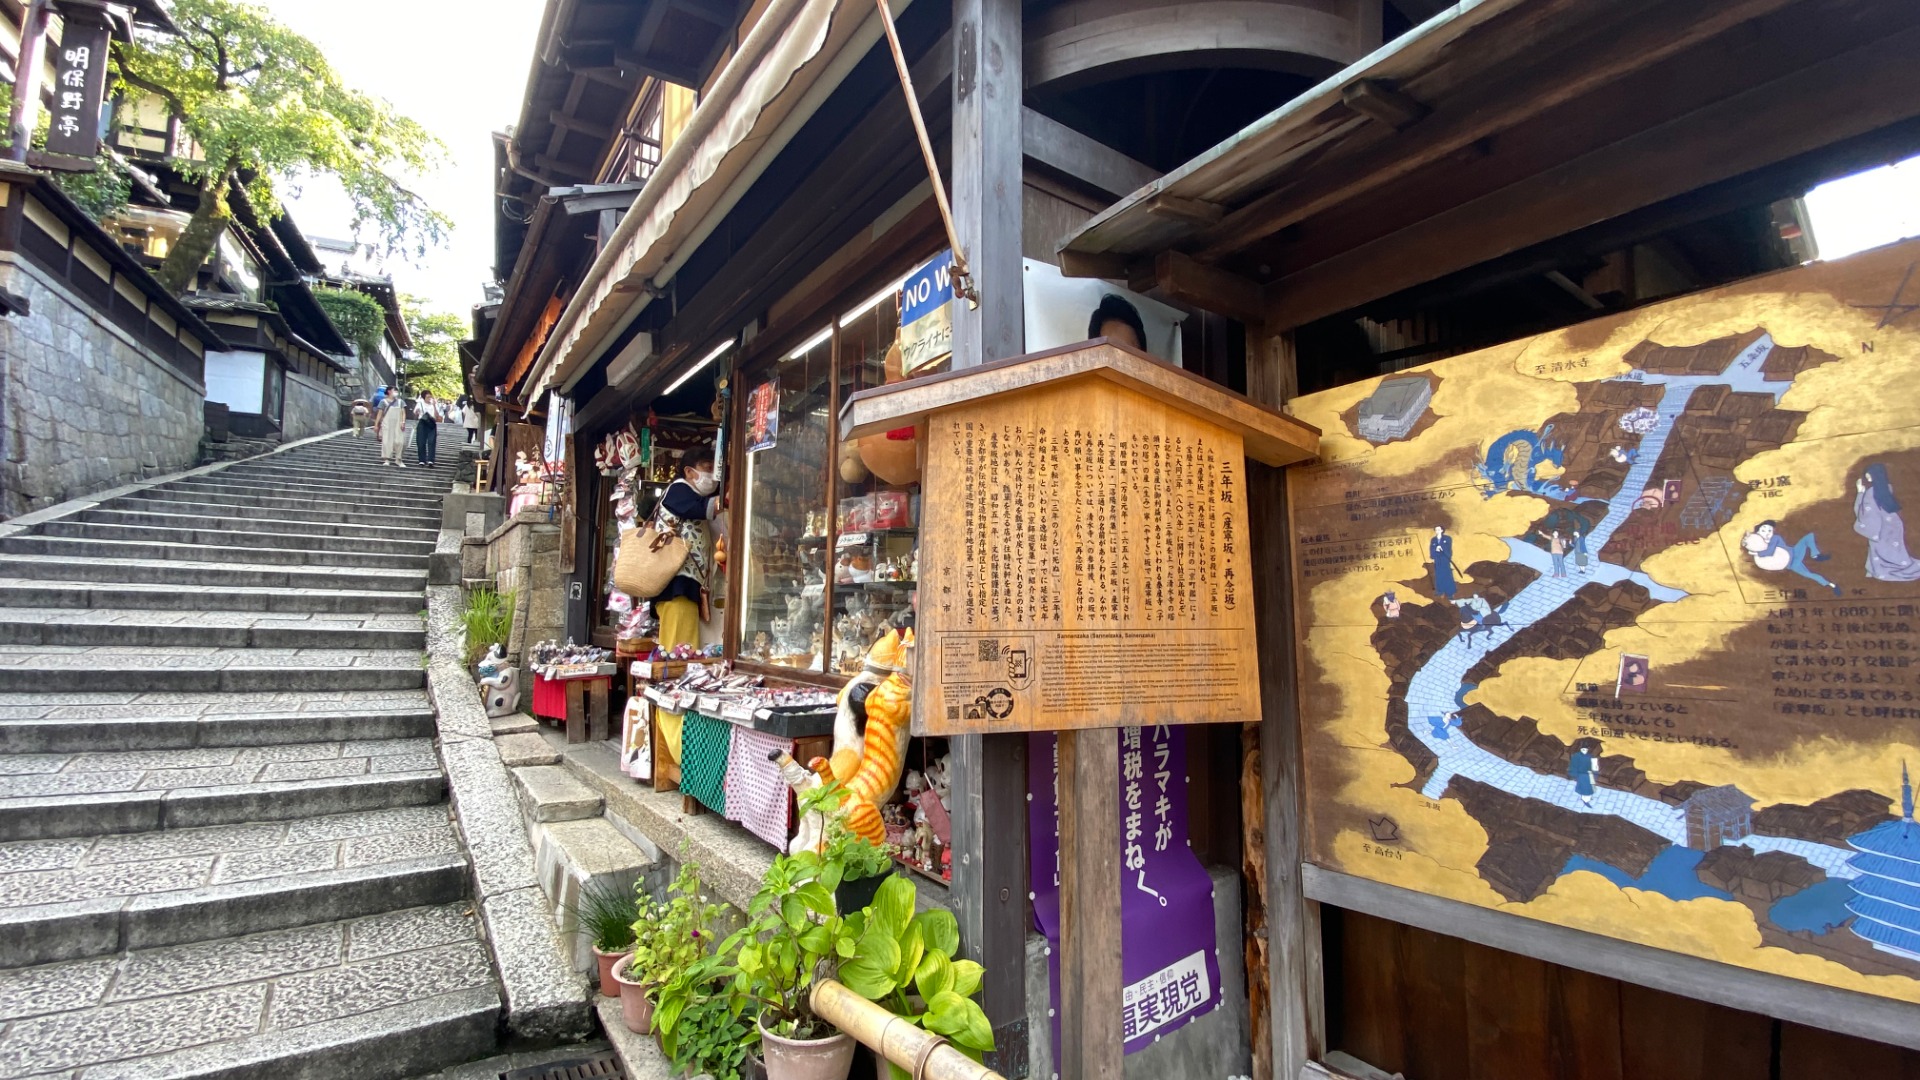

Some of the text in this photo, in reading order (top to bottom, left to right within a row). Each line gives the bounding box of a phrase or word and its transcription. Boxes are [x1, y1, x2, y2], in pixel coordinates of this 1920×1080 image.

[58, 46, 91, 138] 明保野亭
[905, 277, 931, 313] NO
[903, 323, 953, 361] ウクライナに
[1862, 341, 1874, 354] N
[1535, 357, 1588, 375] 至 清水寺
[1062, 429, 1071, 457] とある。
[942, 566, 952, 613] 京都市
[843, 661, 863, 674] Welc
